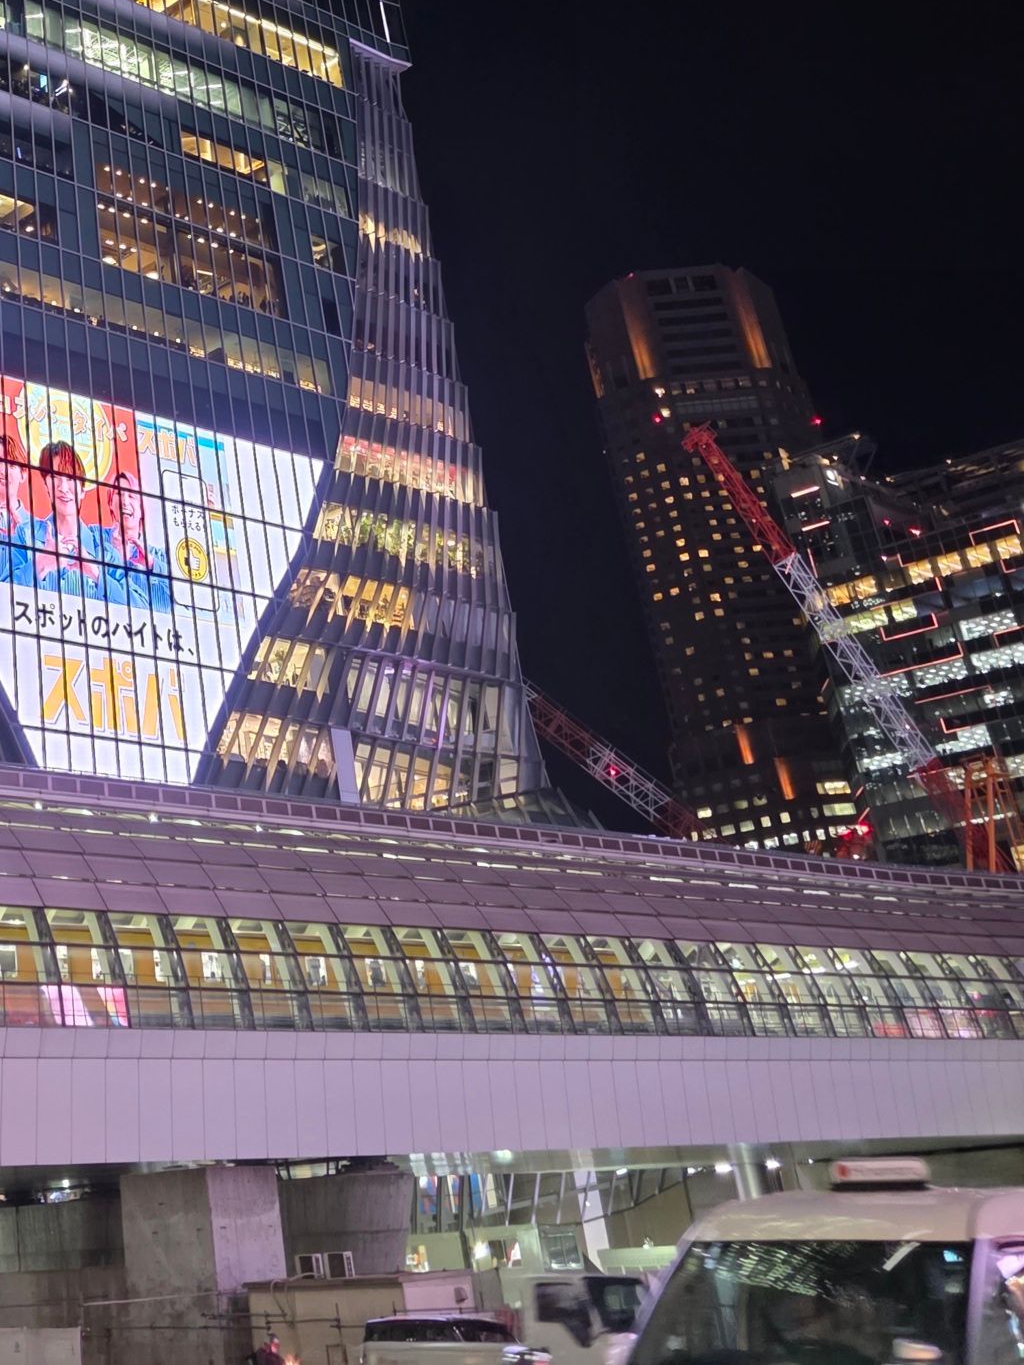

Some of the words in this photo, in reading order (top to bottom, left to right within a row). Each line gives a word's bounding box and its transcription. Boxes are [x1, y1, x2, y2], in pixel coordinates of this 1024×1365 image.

[137, 427, 198, 467] スポバ
[14, 600, 195, 656] スポットのバイトは、
[43, 653, 186, 742] スポバ
